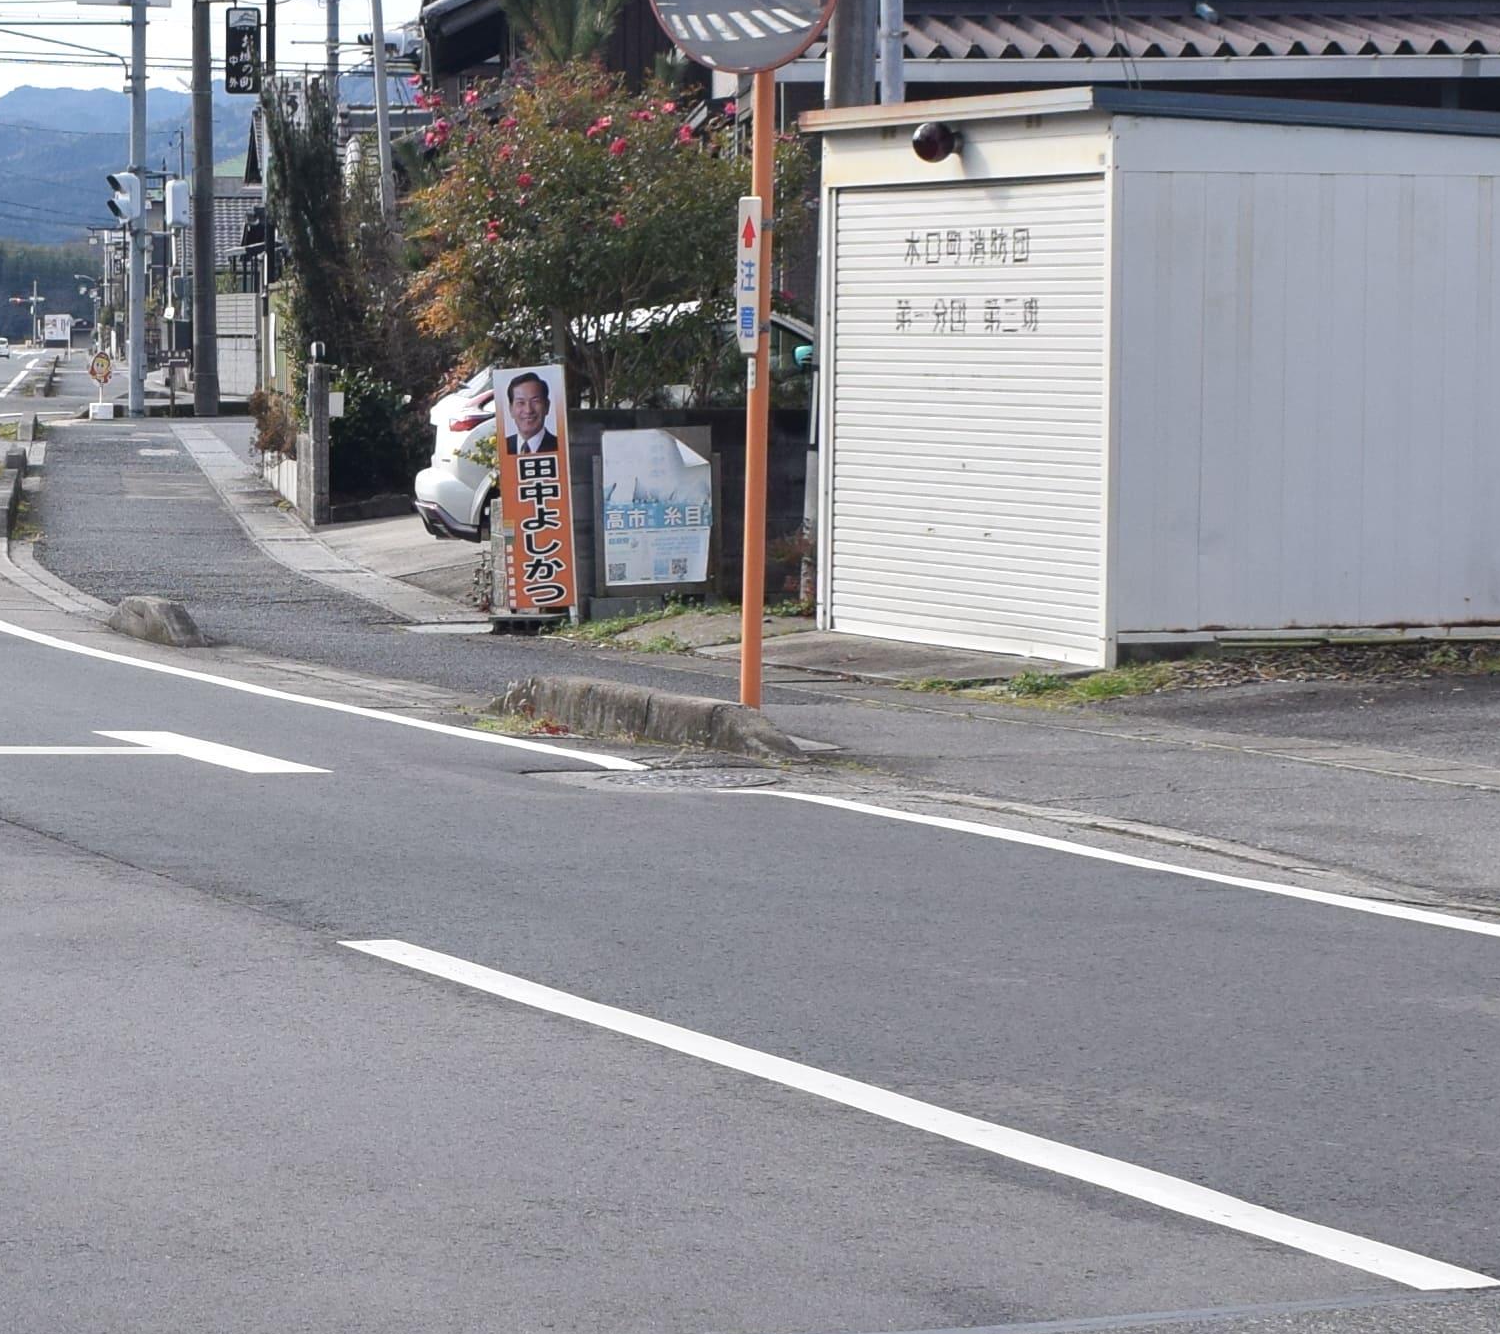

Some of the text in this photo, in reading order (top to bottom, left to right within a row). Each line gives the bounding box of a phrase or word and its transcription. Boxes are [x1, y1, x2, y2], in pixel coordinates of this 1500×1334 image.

[516, 454, 567, 605] 田中よしかつ
